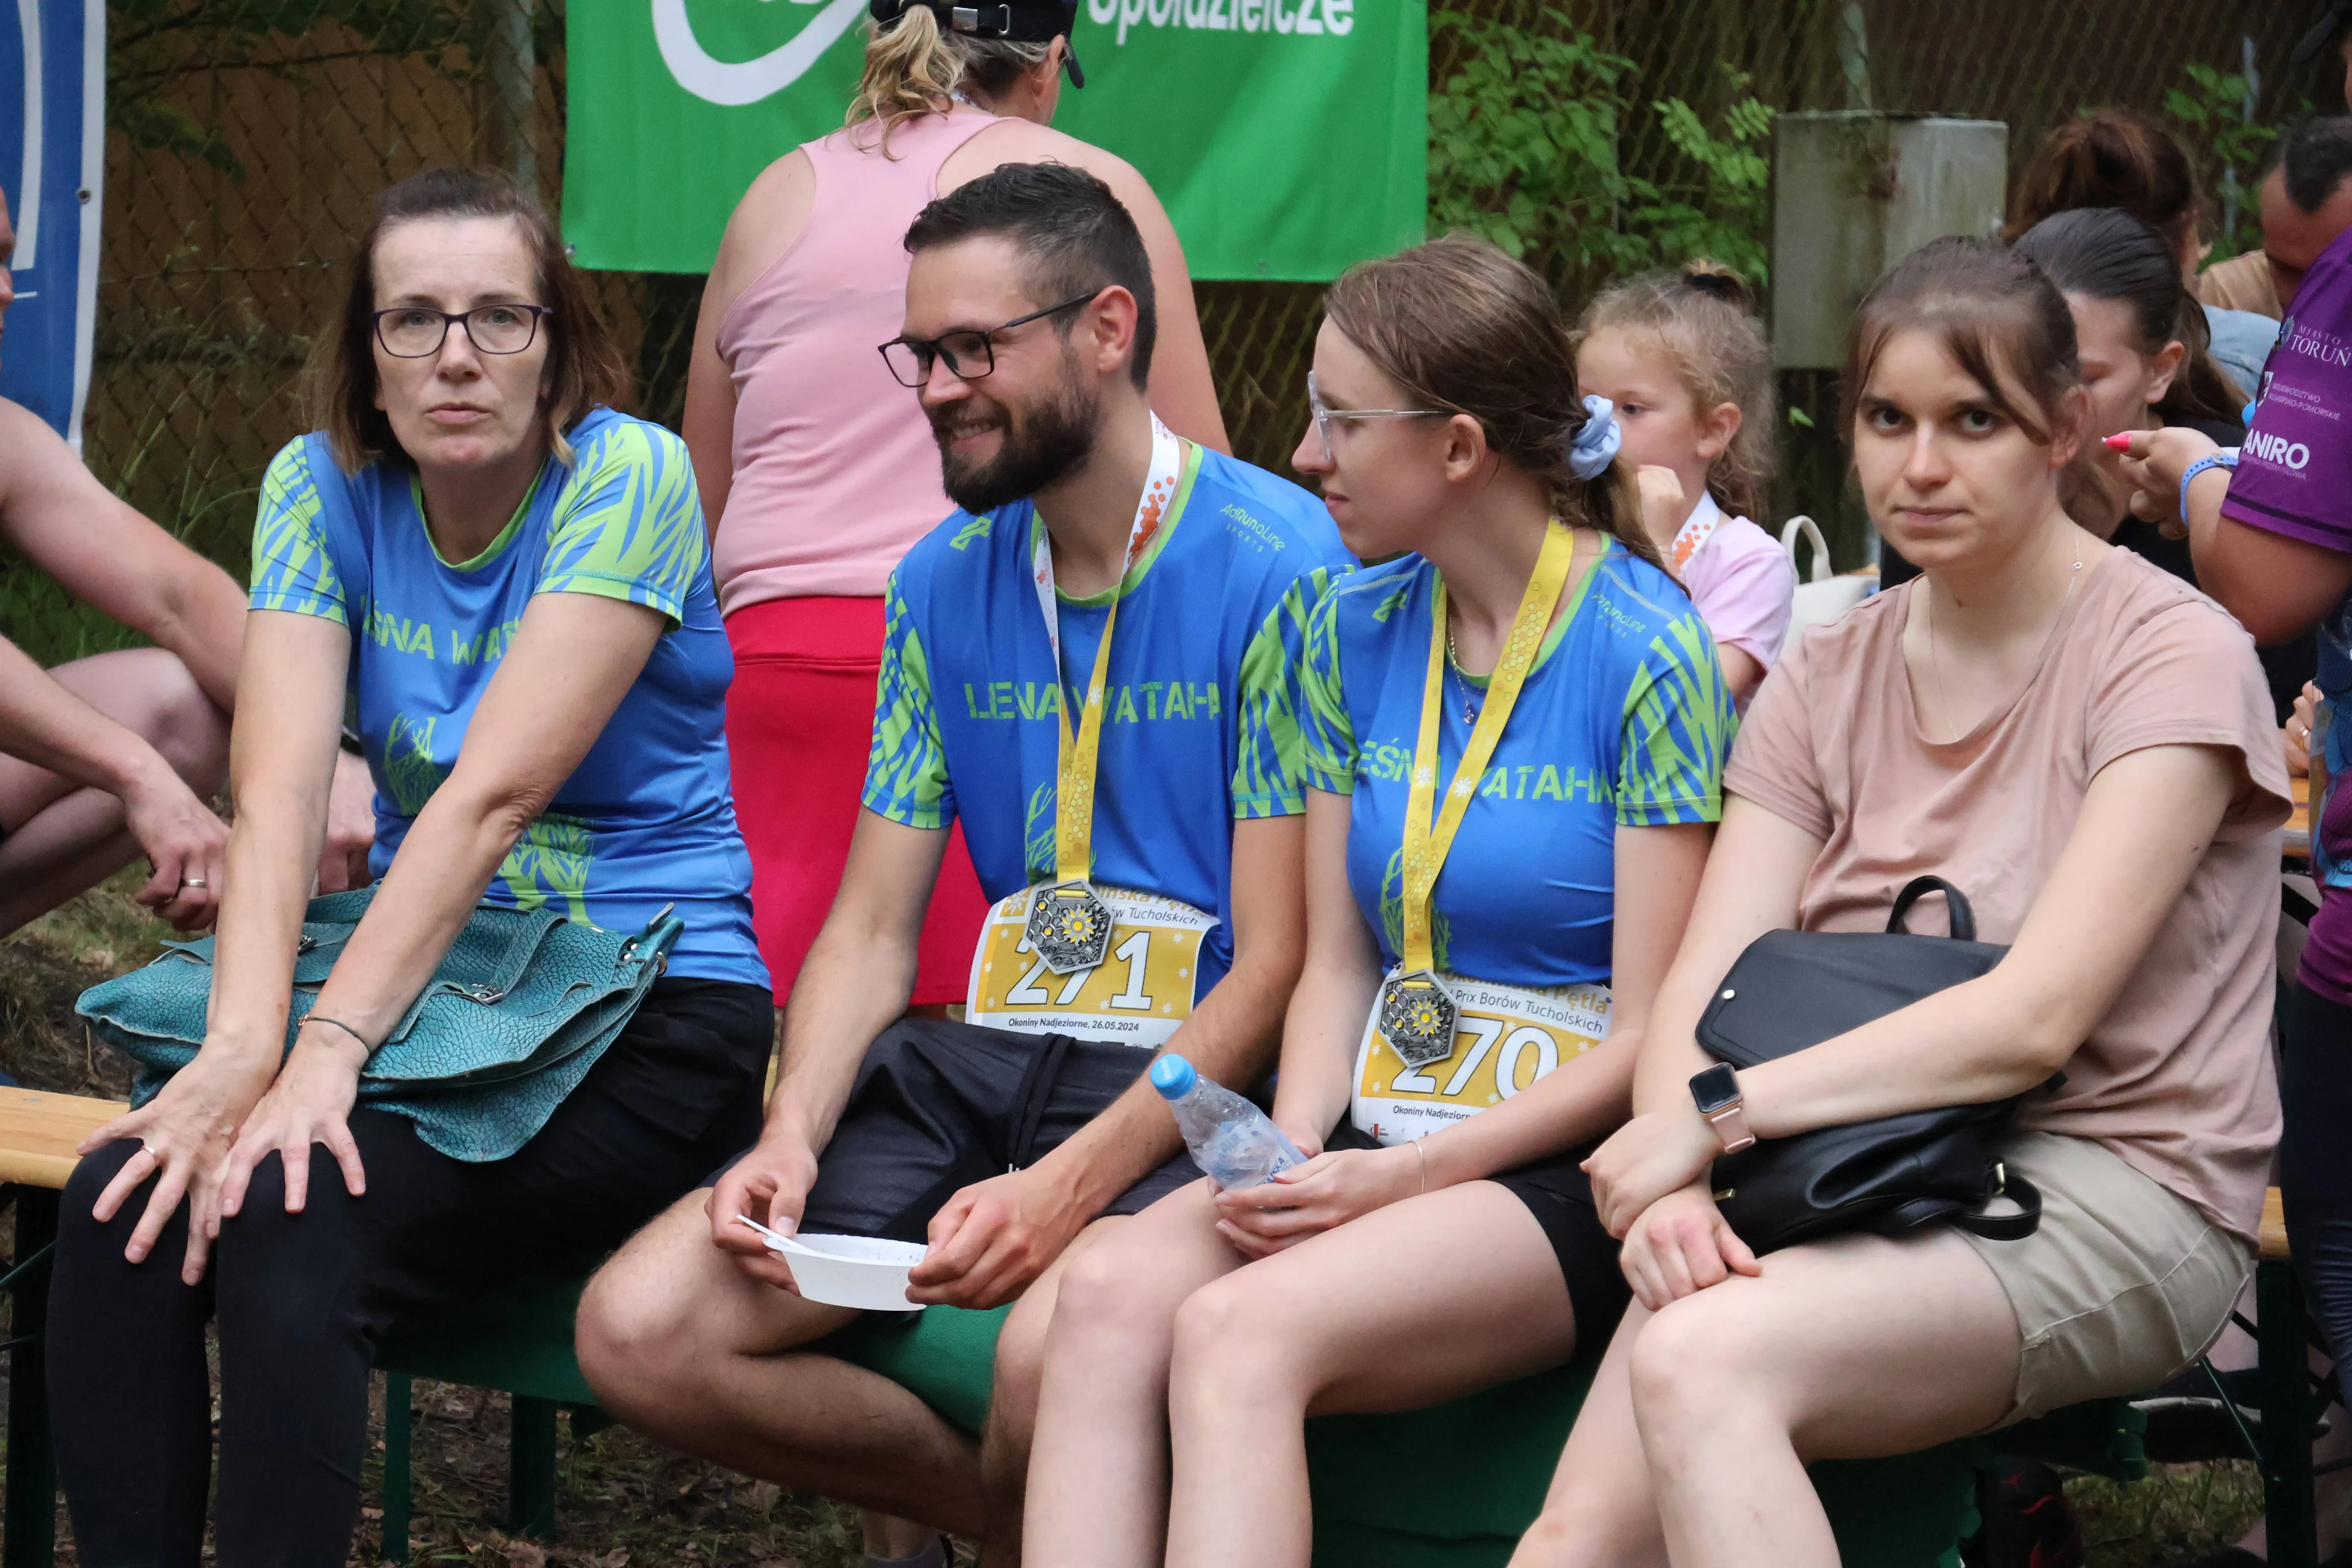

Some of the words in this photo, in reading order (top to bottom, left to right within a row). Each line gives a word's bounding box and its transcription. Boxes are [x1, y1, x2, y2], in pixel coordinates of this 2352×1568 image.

[2291, 335, 2351, 366] TORUŃ
[2243, 428, 2310, 469] ANIRO
[1129, 907, 1198, 925] Tucholskich
[1456, 989, 1476, 1003] Prix
[1480, 992, 1521, 1010] Borów
[1526, 1000, 1602, 1033] Tucholskich
[1009, 1018, 1038, 1028] Okoniny
[1040, 1018, 1090, 1029] Nadjeziorne,
[1092, 1020, 1140, 1031] 26.05.2024
[1393, 1105, 1424, 1117] Okoniny
